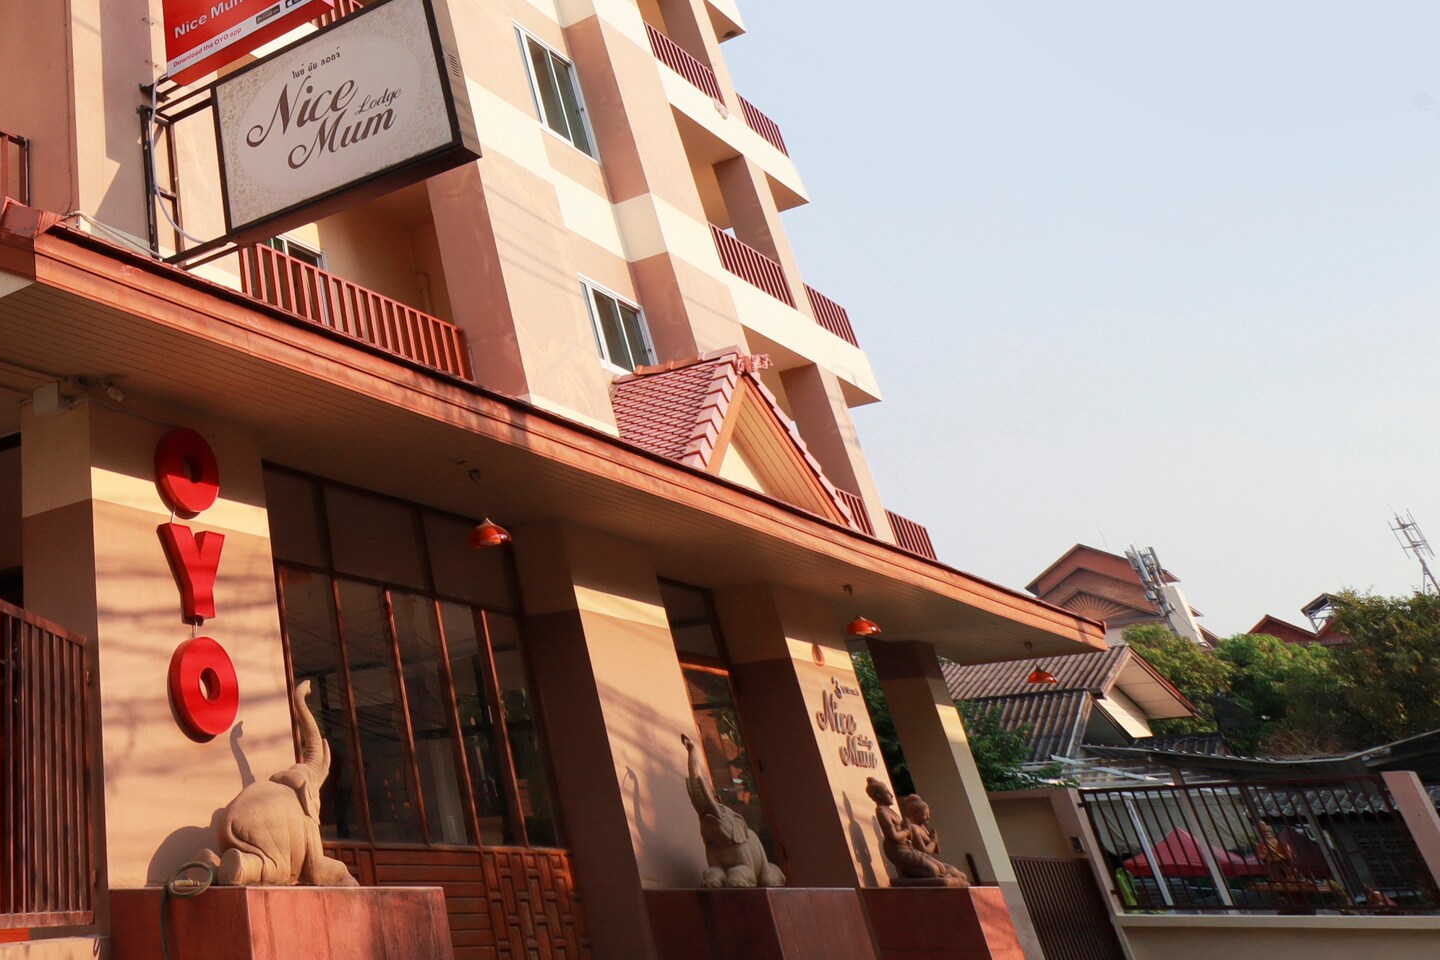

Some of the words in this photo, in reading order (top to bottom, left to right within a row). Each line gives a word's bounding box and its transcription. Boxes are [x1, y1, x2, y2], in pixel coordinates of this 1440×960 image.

[173, 47, 203, 68] Download
[203, 42, 214, 52] the
[214, 33, 229, 46] OYO
[229, 27, 242, 39] app
[174, 14, 208, 39] Nice
[246, 75, 359, 148] Nice
[354, 87, 403, 116] Lodge
[287, 107, 398, 170] Mum
[154, 427, 240, 738] OYO
[815, 688, 857, 736] Nice
